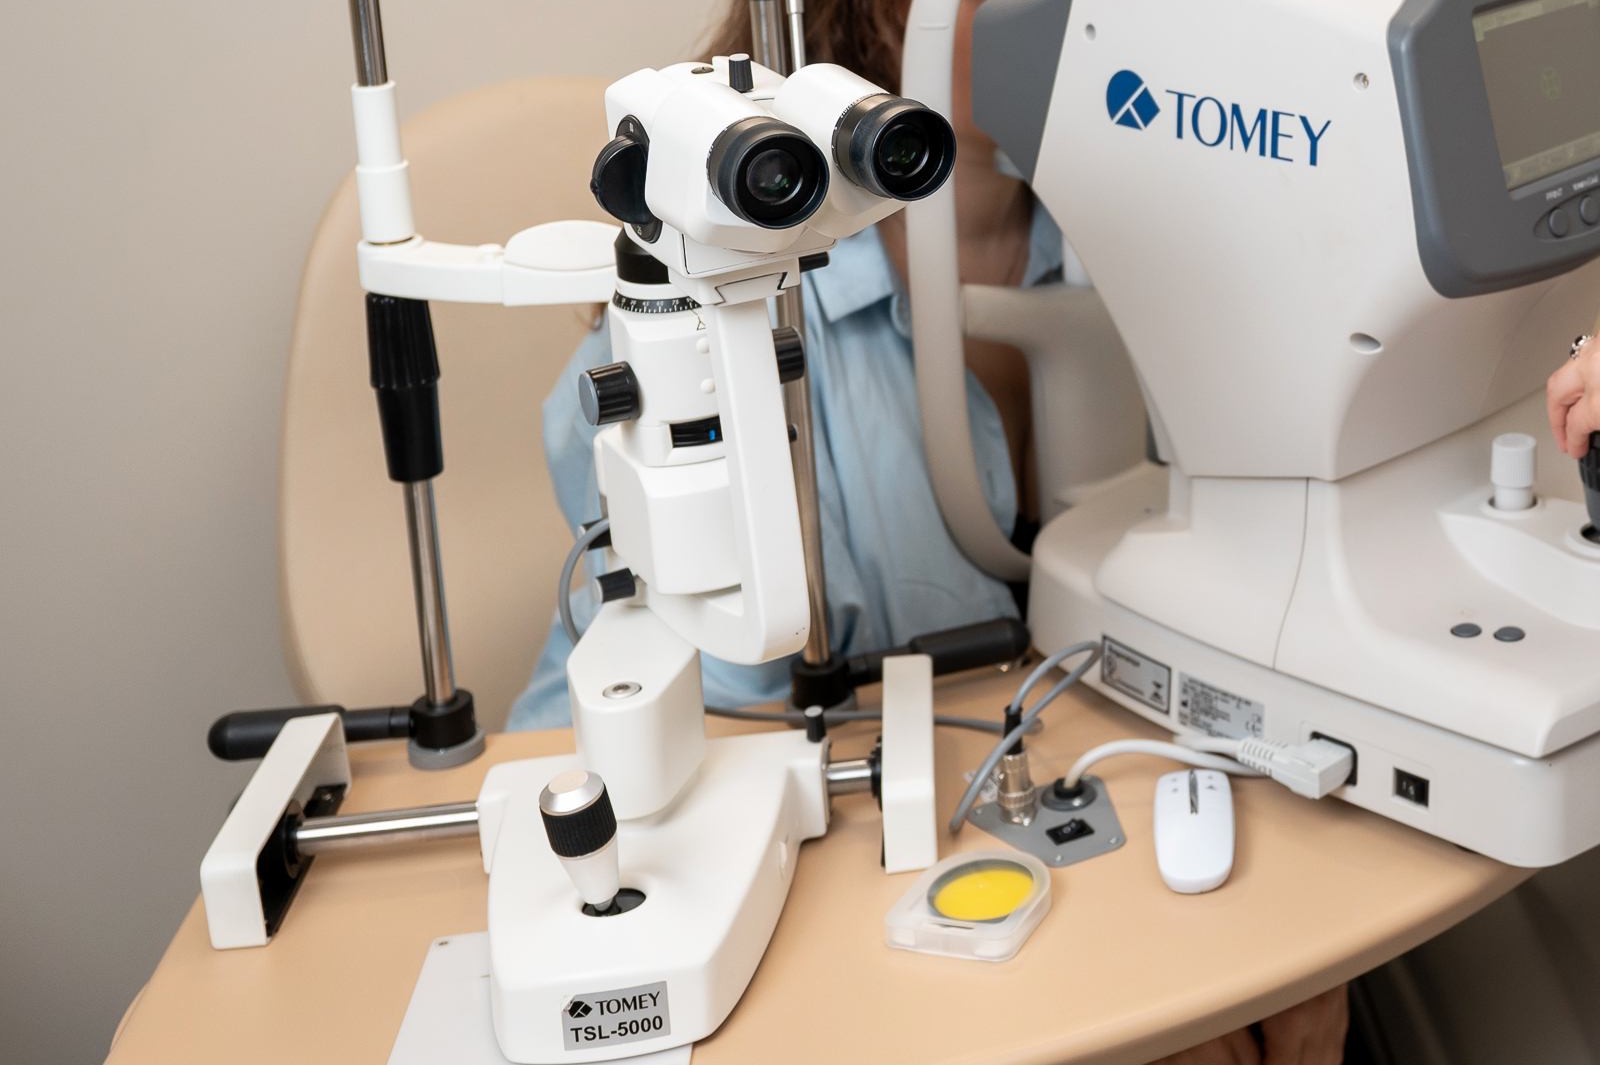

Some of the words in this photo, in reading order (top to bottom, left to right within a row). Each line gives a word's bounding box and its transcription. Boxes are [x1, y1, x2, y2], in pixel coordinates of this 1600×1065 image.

[1165, 89, 1332, 167] TOMEY
[595, 991, 660, 1016] TOMEY
[570, 1016, 663, 1043] TSL-5000
